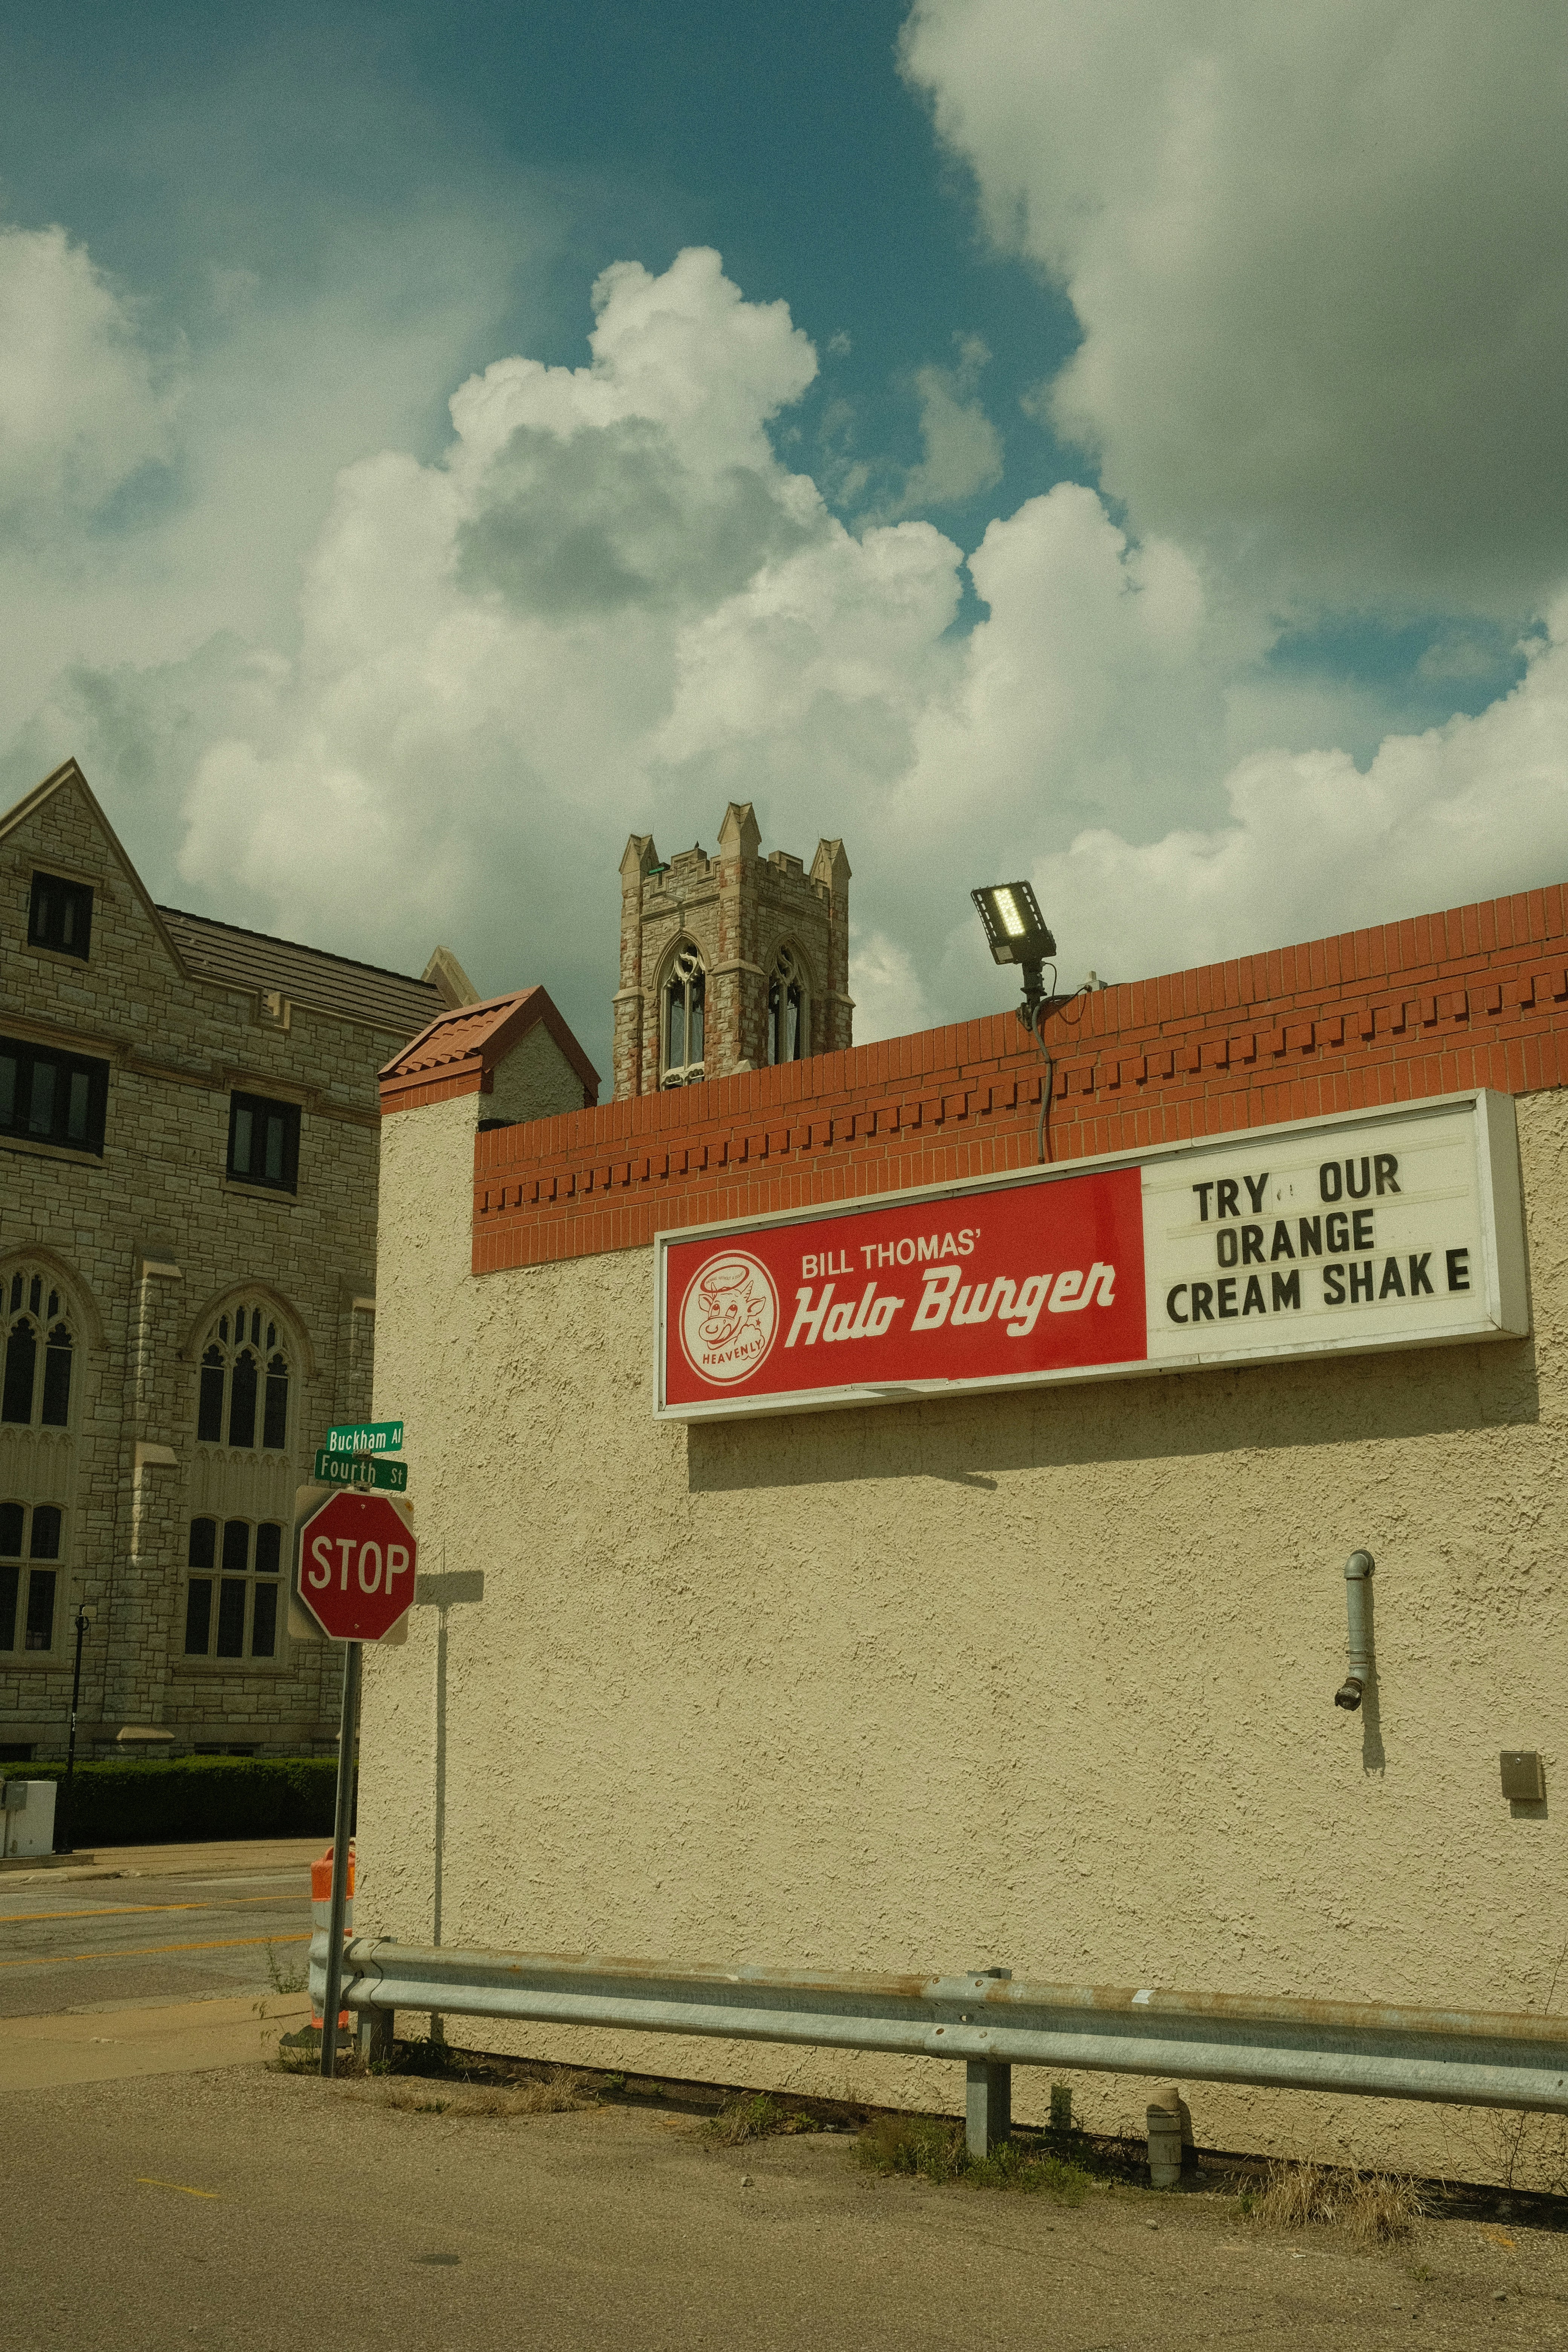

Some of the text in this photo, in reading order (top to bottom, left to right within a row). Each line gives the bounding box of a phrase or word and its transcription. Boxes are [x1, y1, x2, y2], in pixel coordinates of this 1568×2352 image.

[1193, 1153, 1401, 1221] TRY OUR
[802, 1249, 853, 1279] BILL
[1216, 1208, 1374, 1268] ORANGE
[784, 1261, 1116, 1348] Halo Burger
[1166, 1248, 1470, 1324] CREAM SHAKE
[703, 1339, 761, 1364] HEAVENLY
[321, 1455, 403, 1485] Fourth St
[329, 1430, 386, 1452] Buckham
[308, 1535, 410, 1595] STOP
